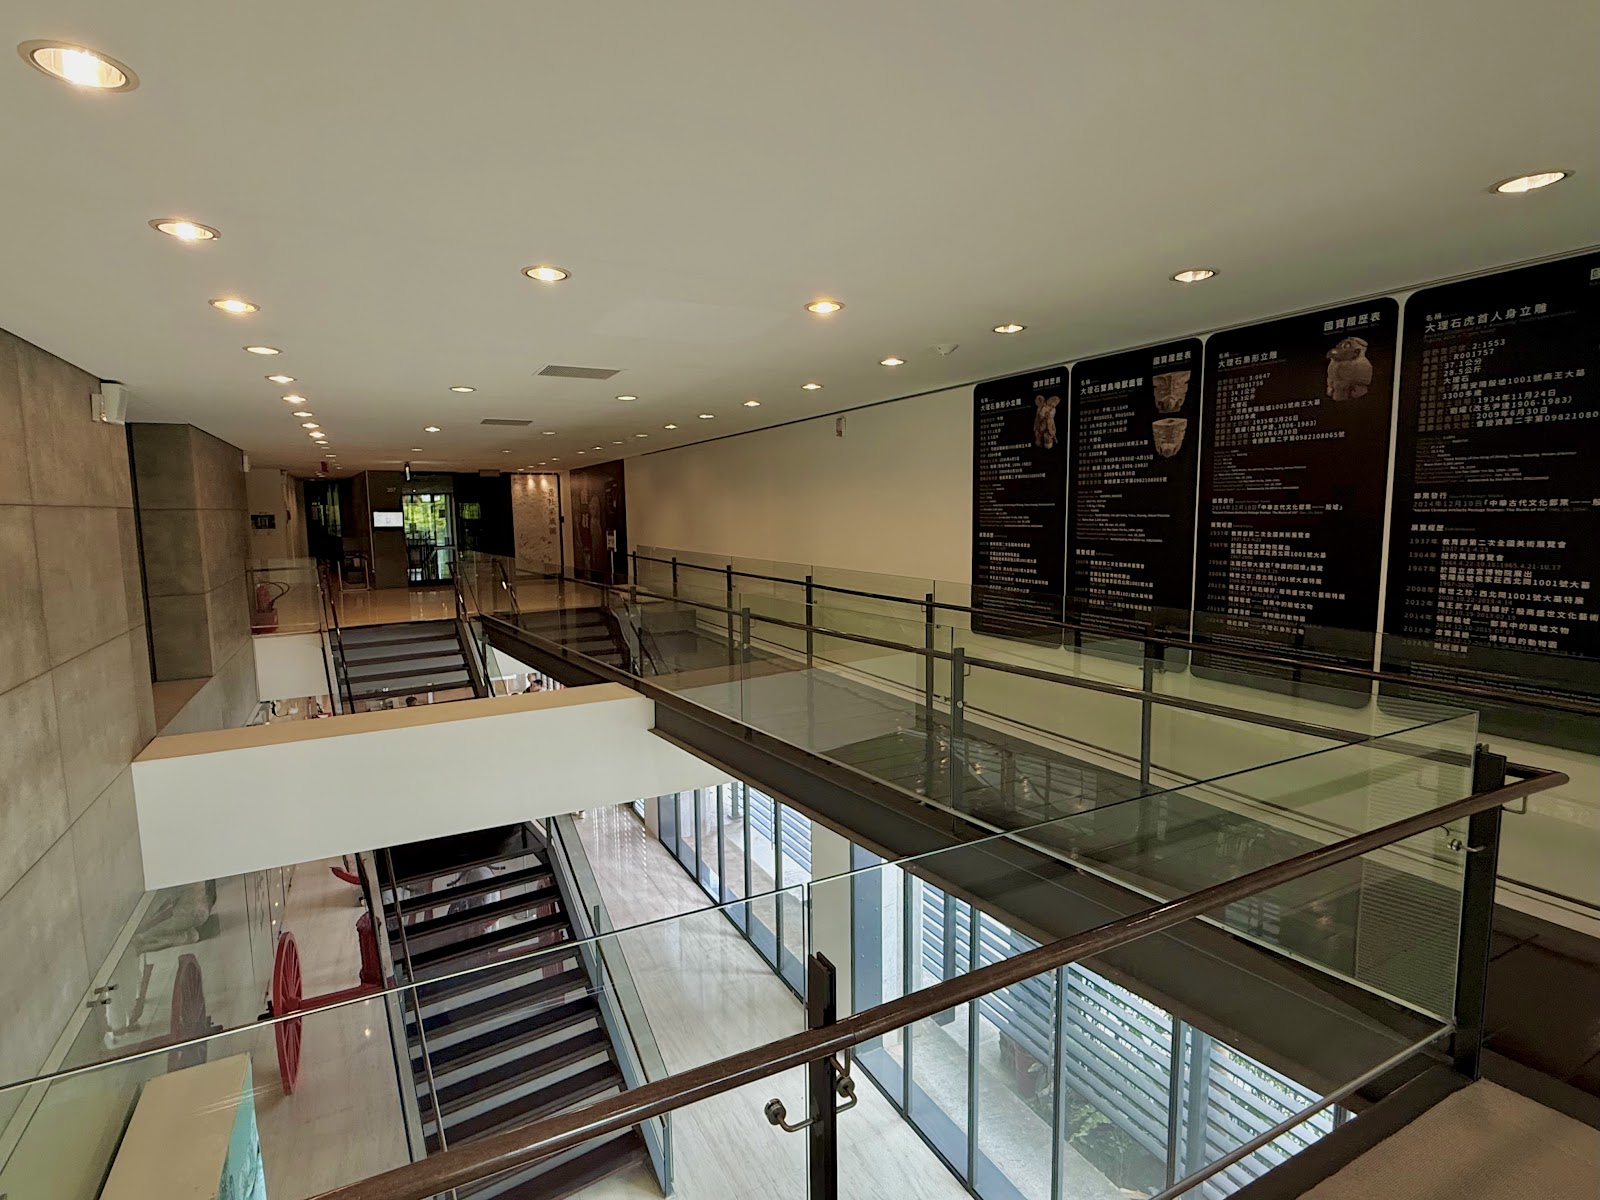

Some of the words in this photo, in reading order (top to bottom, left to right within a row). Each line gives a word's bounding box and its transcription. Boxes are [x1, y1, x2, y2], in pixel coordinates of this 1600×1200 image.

[1323, 312, 1381, 332] 國寶履歷表
[1425, 303, 1548, 333] 大理石虎首人身立雕
